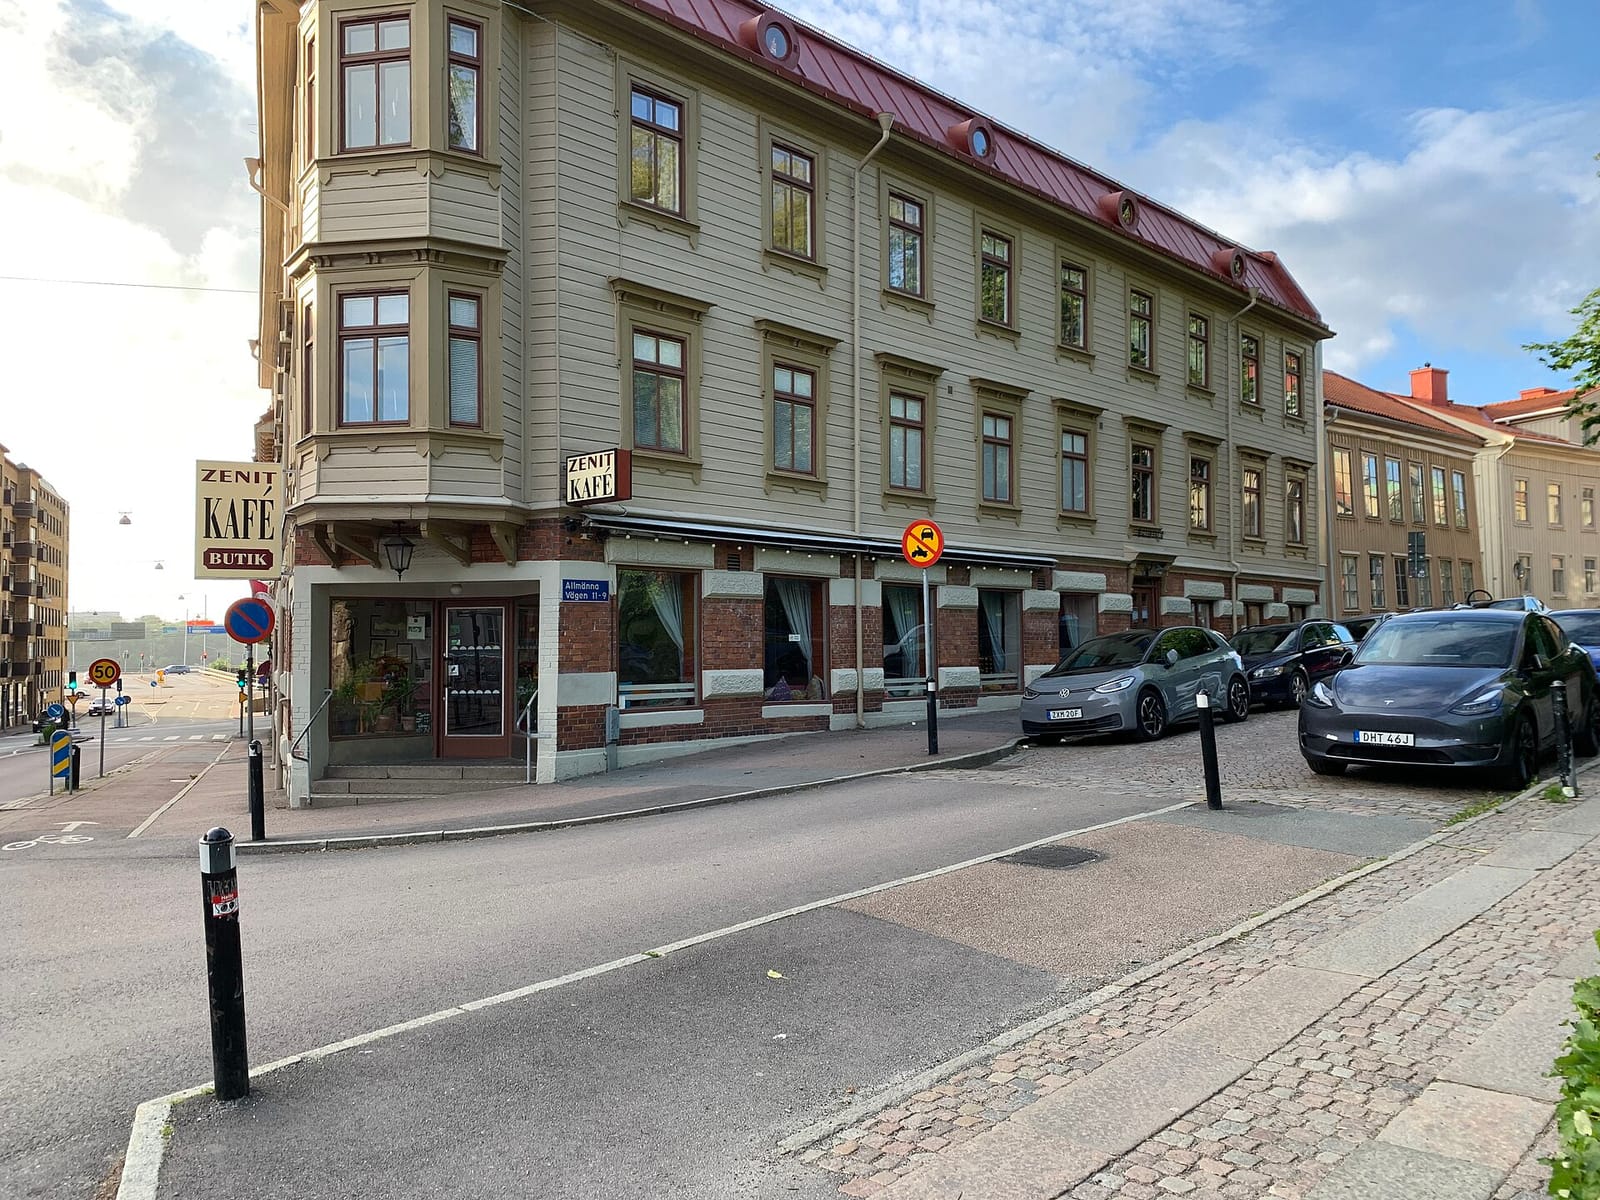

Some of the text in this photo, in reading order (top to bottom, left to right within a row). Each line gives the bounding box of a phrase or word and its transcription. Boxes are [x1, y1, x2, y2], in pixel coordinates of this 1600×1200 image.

[569, 452, 614, 473] ZENIT
[201, 468, 277, 485] ZENIT
[570, 466, 613, 500] KAFÉ
[202, 485, 275, 540] KAFÉ
[209, 552, 268, 566] BUTIK
[565, 591, 589, 601] Vägen
[94, 665, 115, 679] 50
[1363, 732, 1409, 745] DHT 46J
